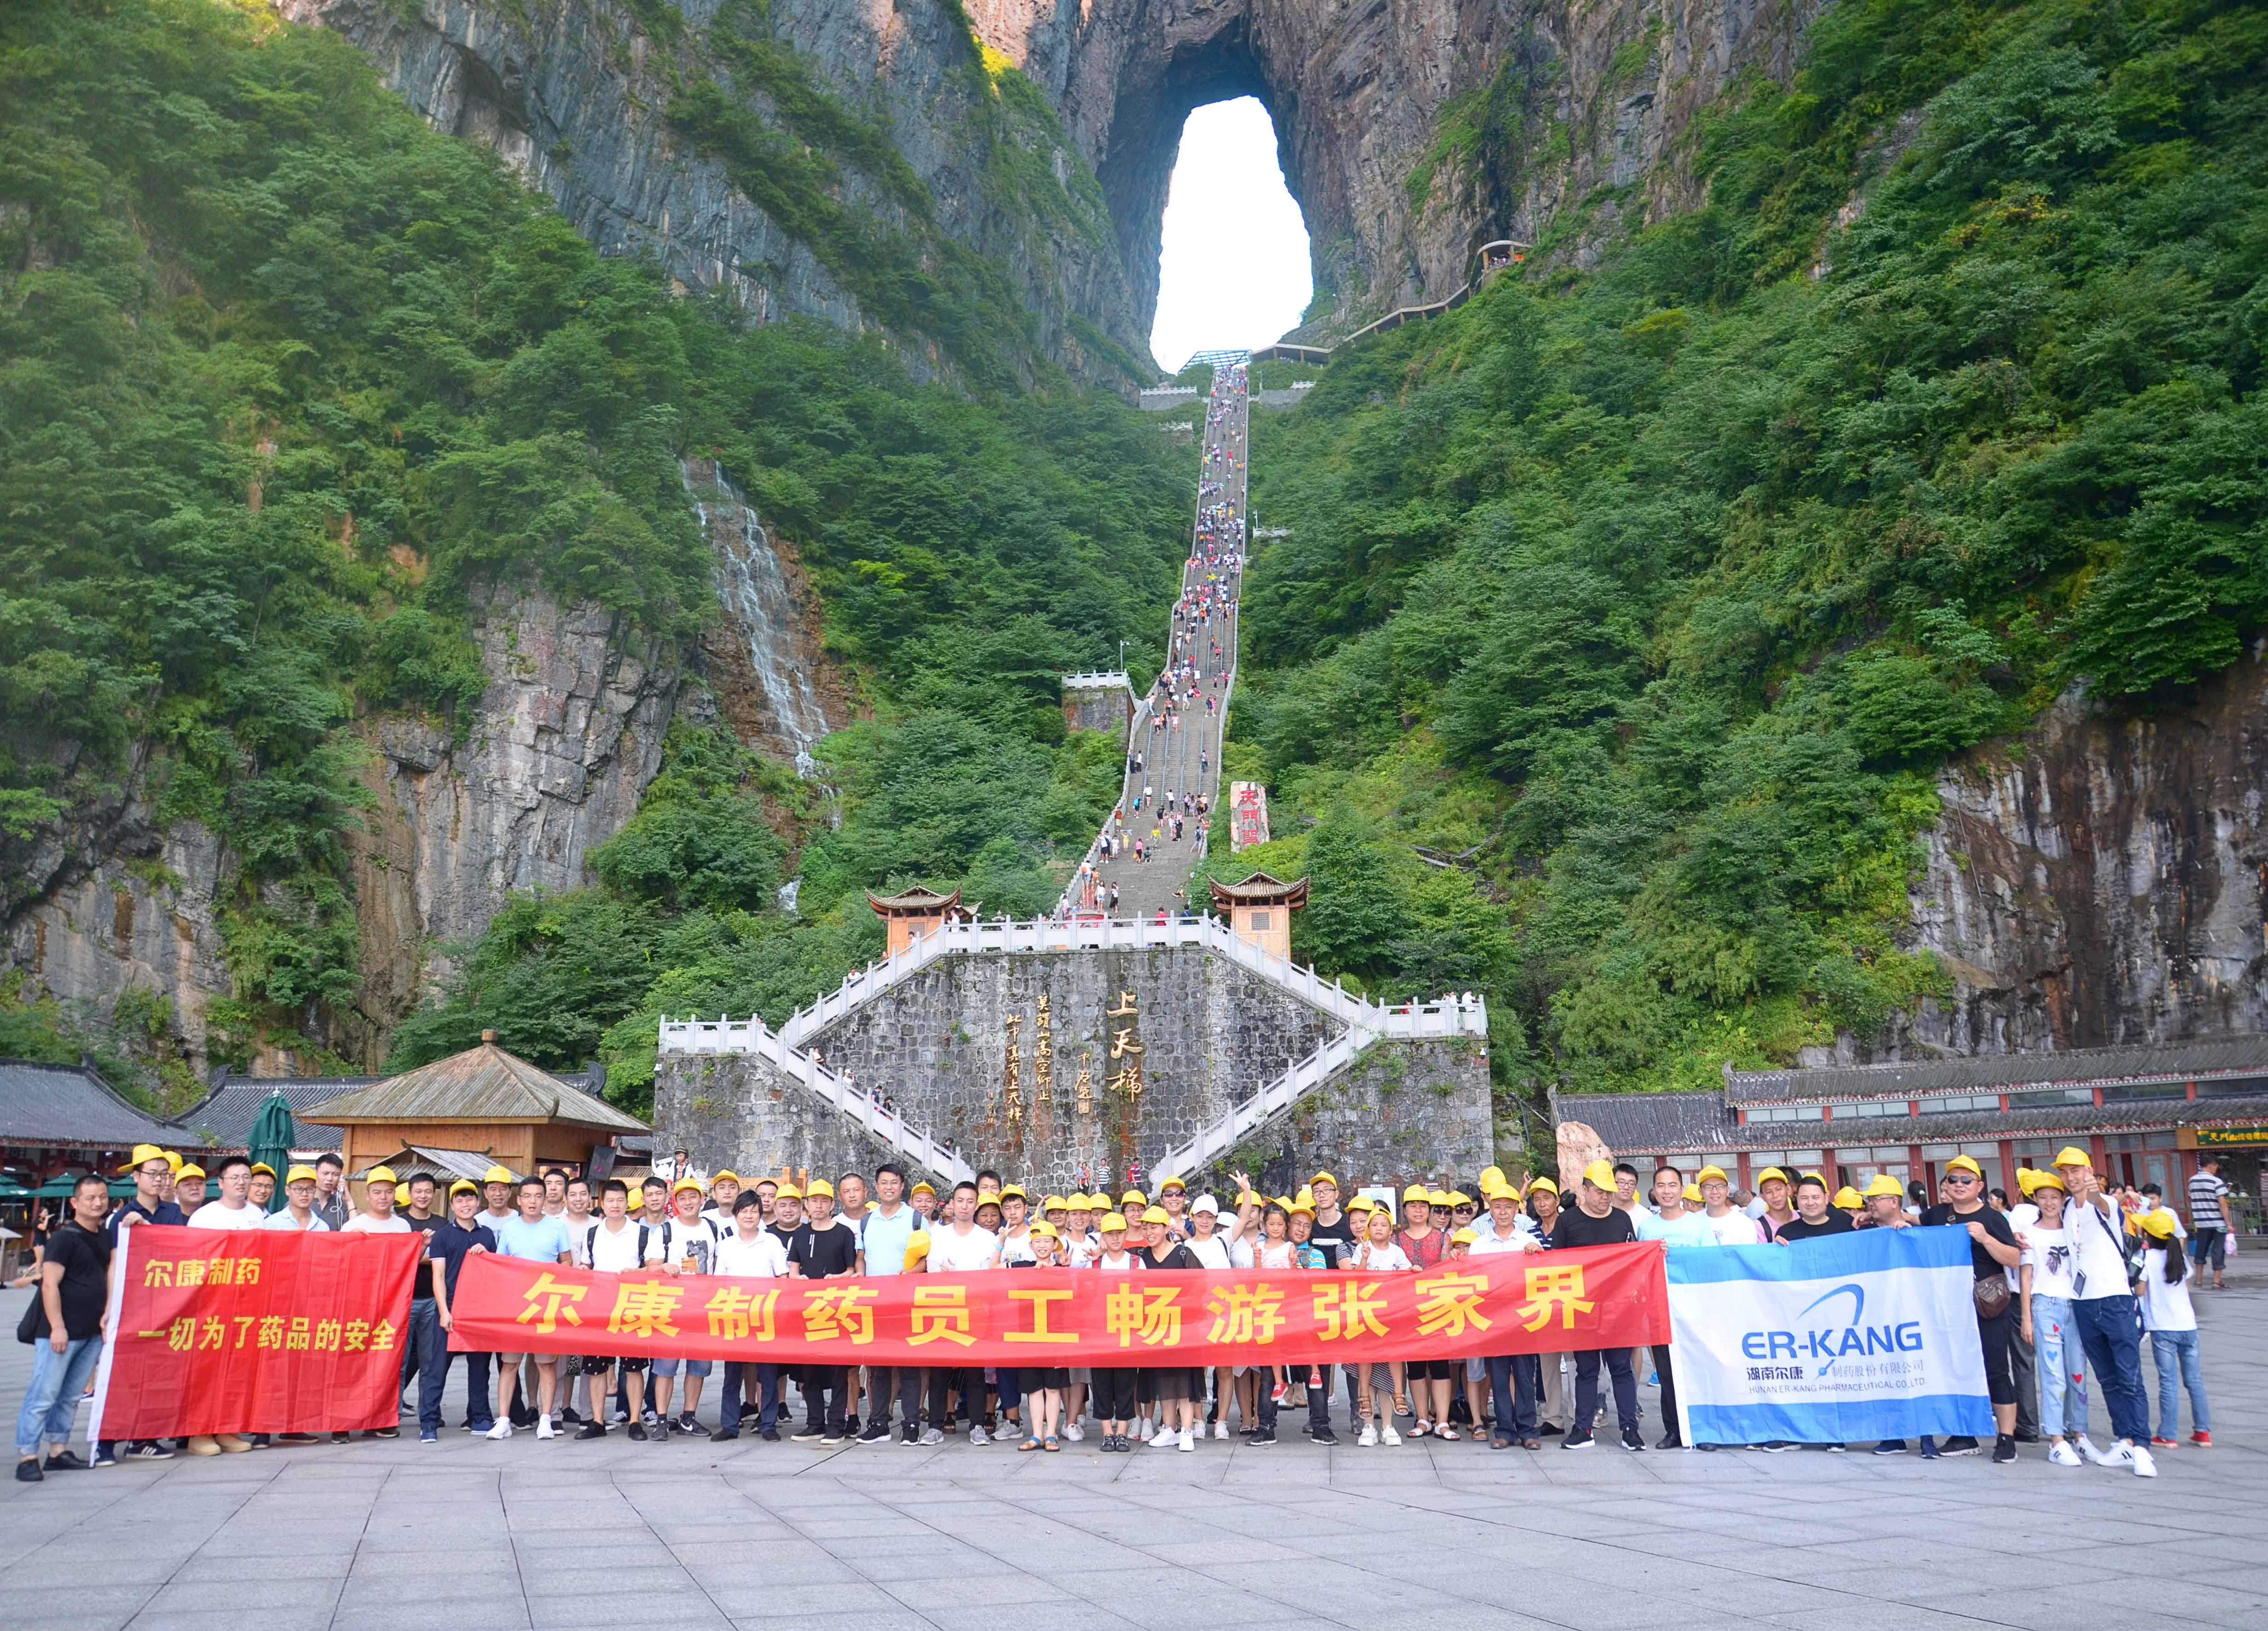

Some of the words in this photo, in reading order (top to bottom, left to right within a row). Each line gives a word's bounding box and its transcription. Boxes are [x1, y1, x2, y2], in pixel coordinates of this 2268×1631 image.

[1105, 991, 1143, 1103] 上天梯
[144, 1257, 262, 1287] 尔康制药
[516, 1265, 1595, 1347] 尔康制药员工畅游张家界
[139, 1315, 395, 1352] 一切为了药品的安全
[1742, 1321, 1923, 1359] ER-KANG
[1746, 1366, 1804, 1381] 湖南尔康
[1832, 1360, 1924, 1378] 制药股份有限公司
[1749, 1385, 1777, 1393] HUNAN
[1780, 1384, 1817, 1393] ER-KANG
[1819, 1381, 1893, 1392] PHARMACEUTICAL
